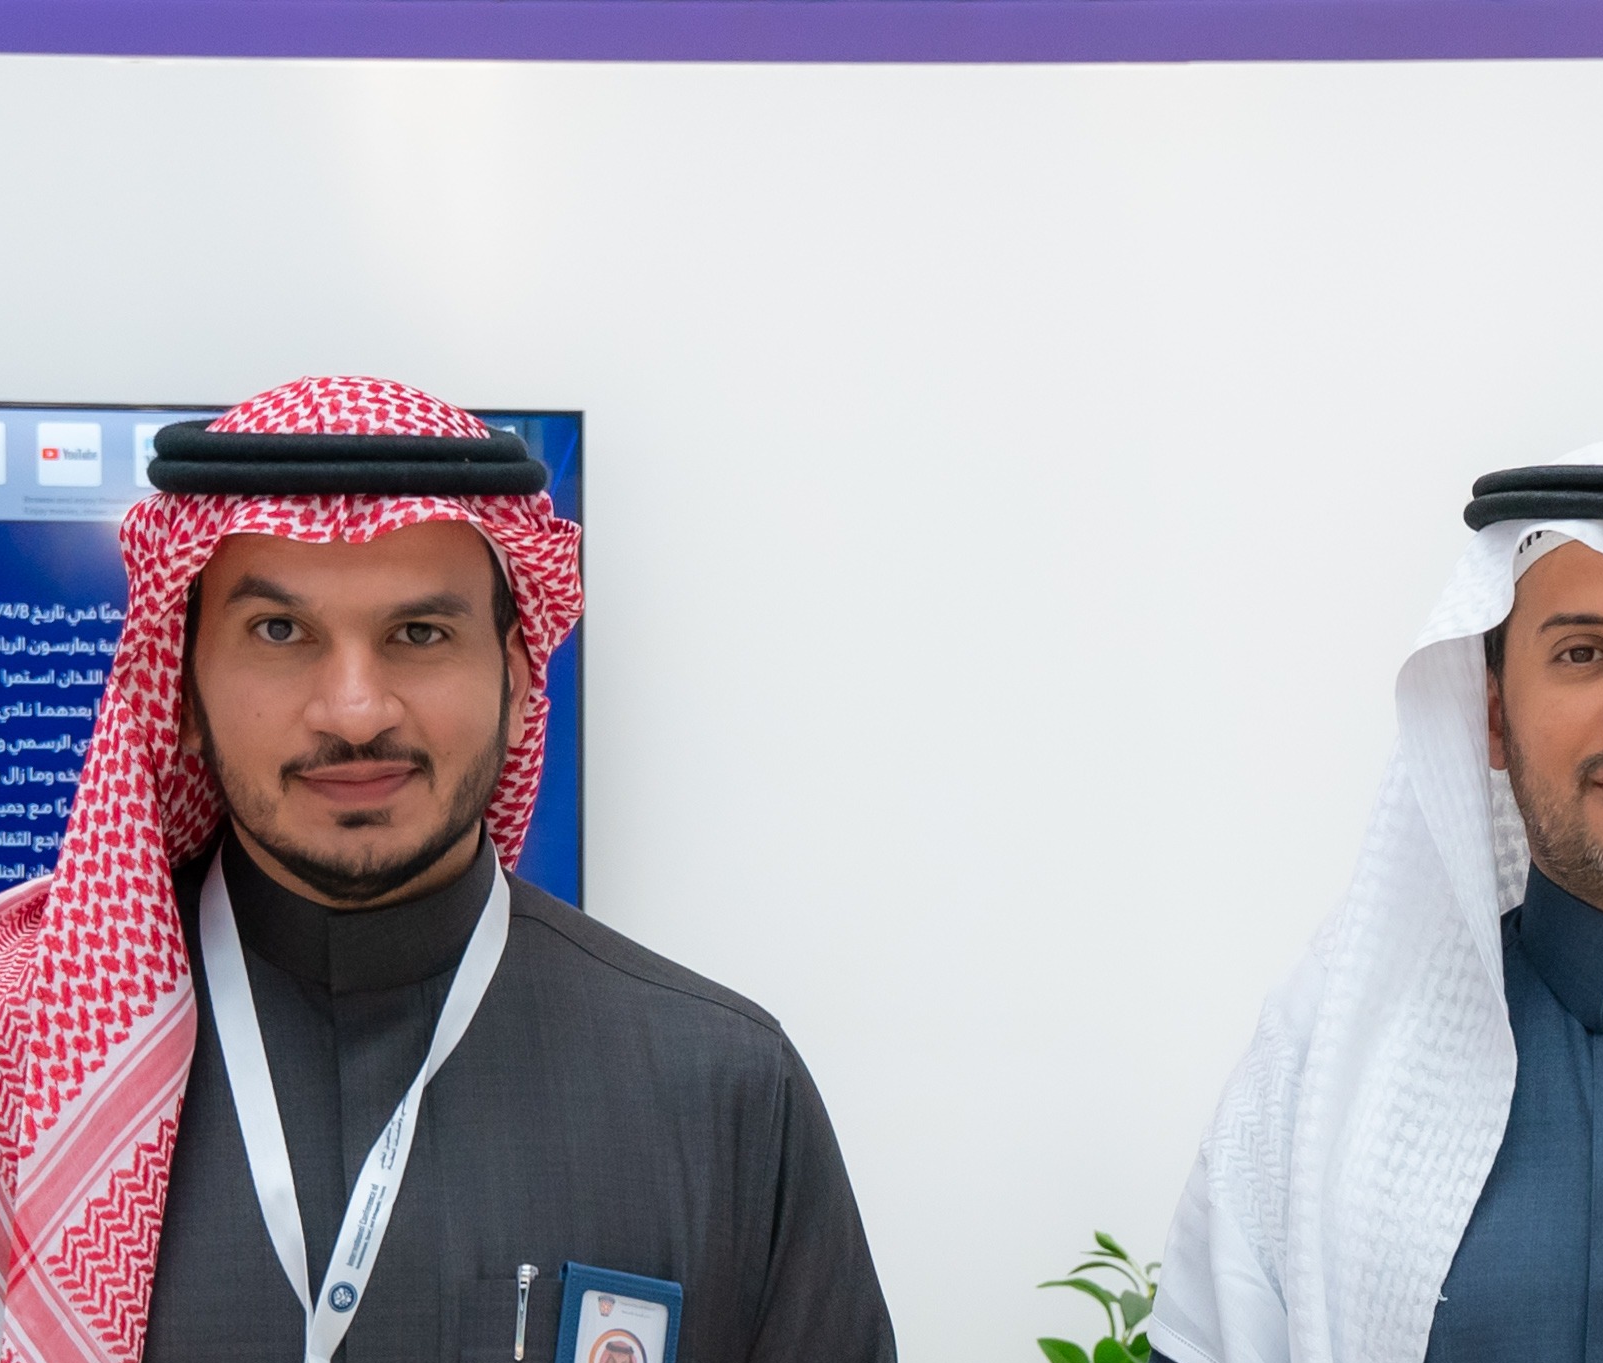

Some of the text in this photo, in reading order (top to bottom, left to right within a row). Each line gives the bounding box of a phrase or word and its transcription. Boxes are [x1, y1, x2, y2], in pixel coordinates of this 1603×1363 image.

[62, 448, 97, 460] YouTube
[29, 603, 65, 625] تاريخ
[67, 606, 97, 626] في
[28, 636, 95, 656] يمارسون
[1, 669, 55, 687] استمرا
[57, 668, 103, 688] اللذان
[35, 701, 92, 721] بعدهما
[7, 734, 71, 755] الرسمي
[26, 802, 53, 820] مع
